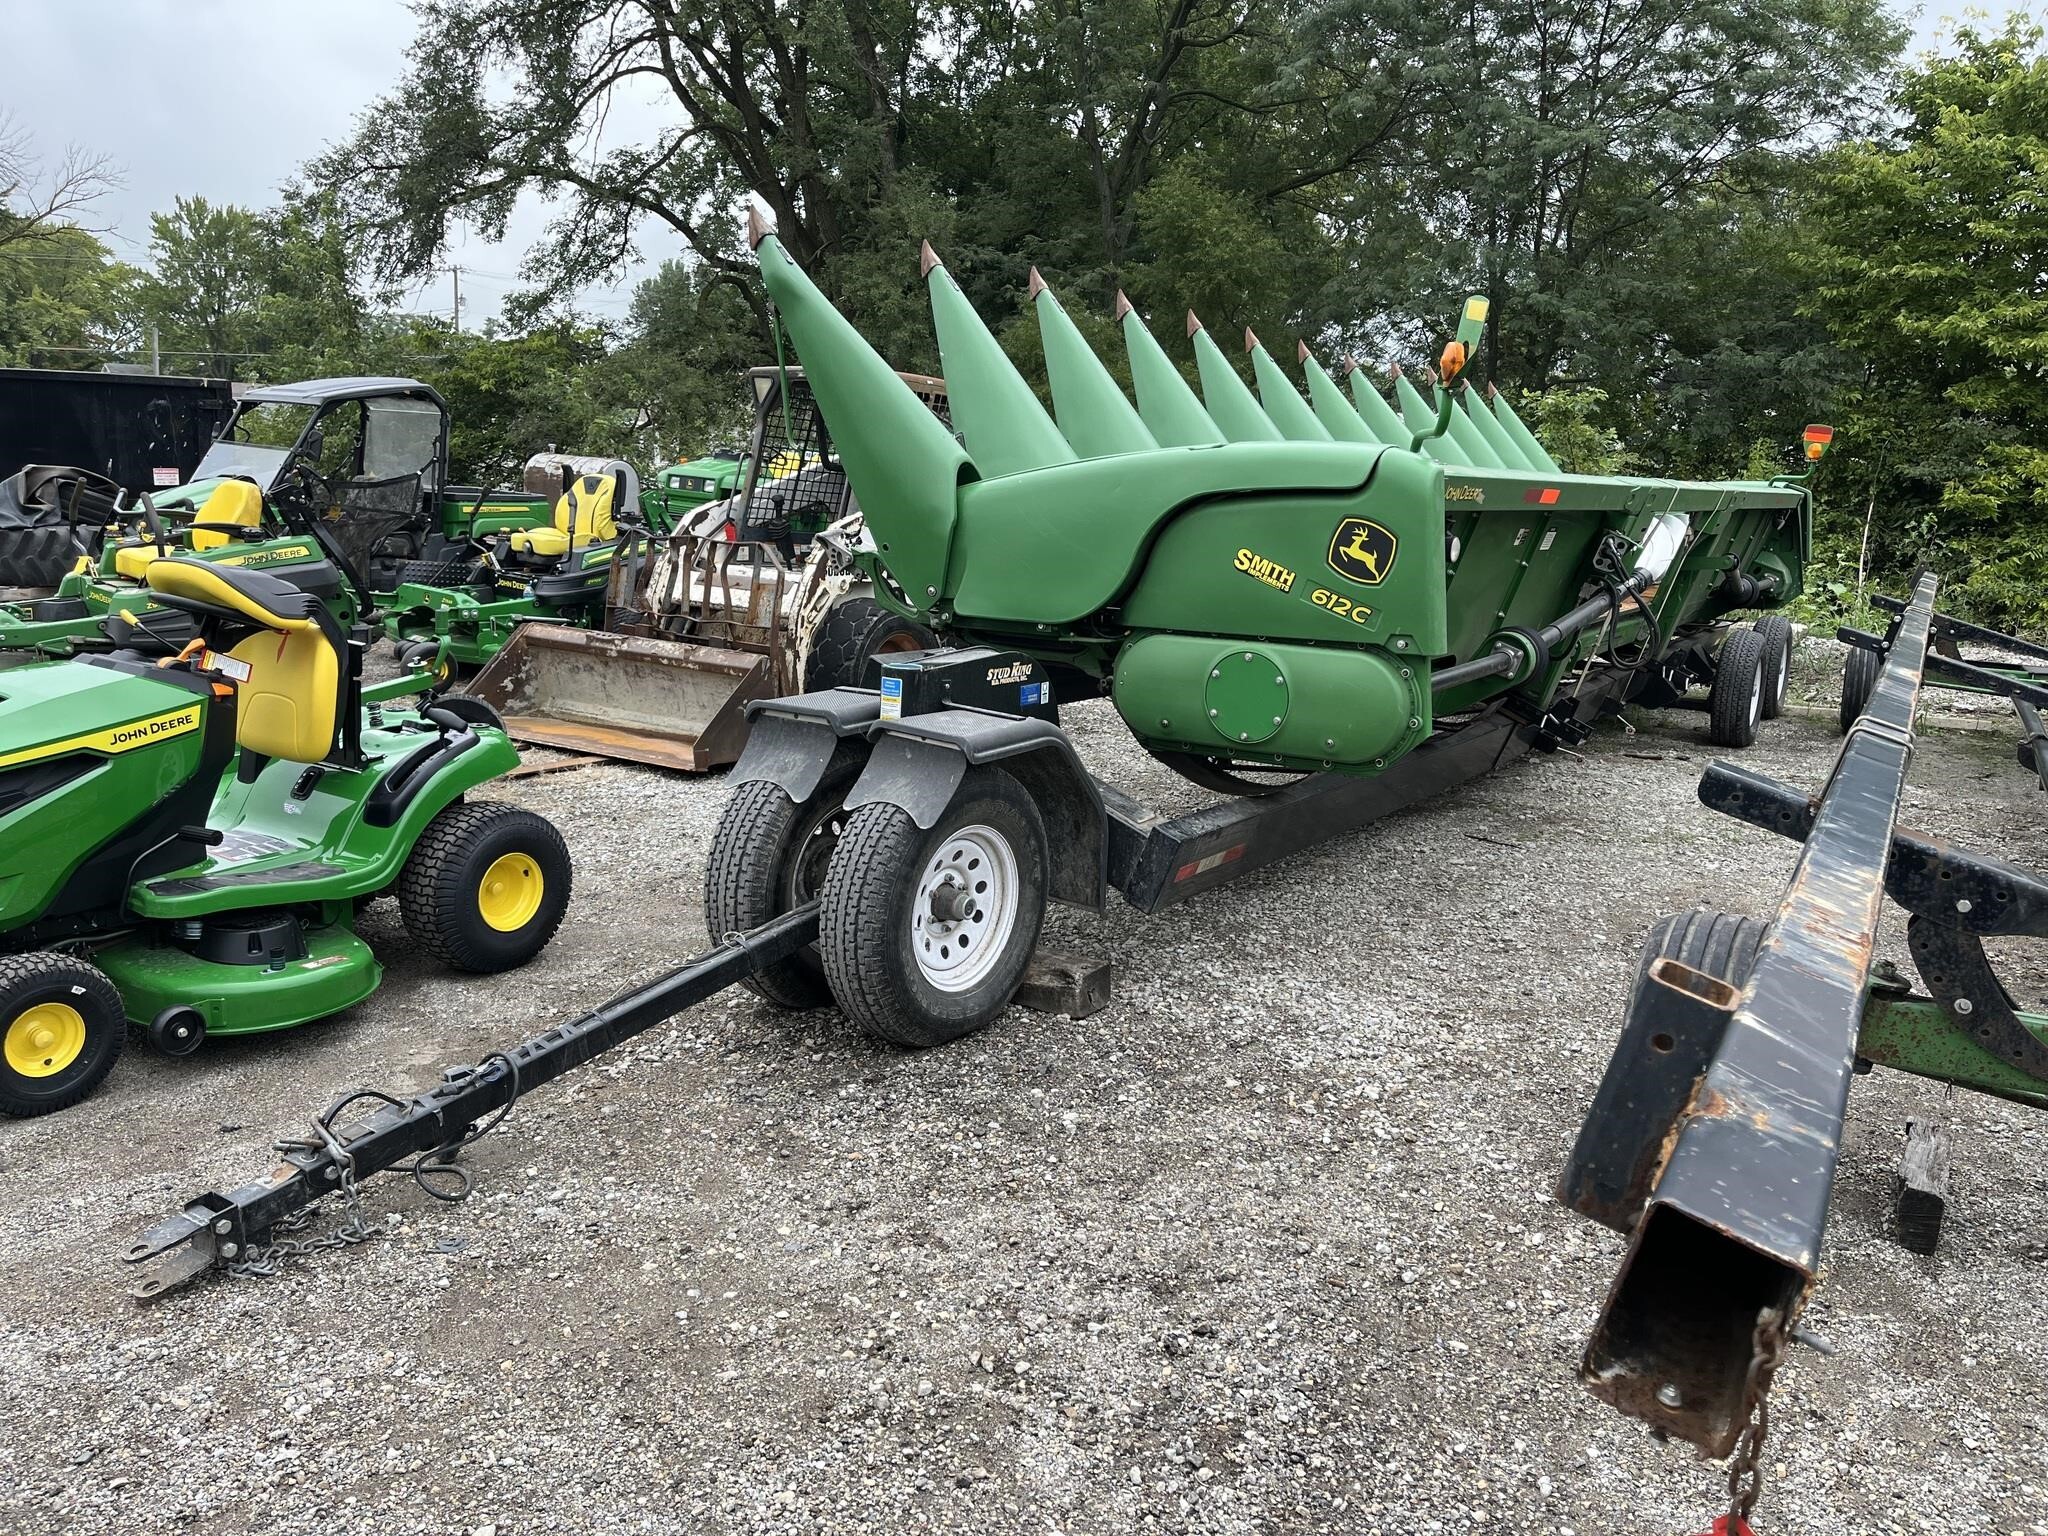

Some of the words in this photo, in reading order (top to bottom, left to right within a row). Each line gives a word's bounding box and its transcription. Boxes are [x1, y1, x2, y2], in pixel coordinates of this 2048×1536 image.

[241, 553, 269, 565] JOHN
[269, 549, 302, 560] DEERE
[1233, 548, 1296, 586] SMITH
[498, 578, 512, 588] JOHN
[512, 580, 527, 590] DEER
[1247, 567, 1290, 592] IMPLEMENTS
[1311, 588, 1372, 624] 612C
[986, 667, 1010, 680] STUD
[1010, 664, 1032, 677] KING
[110, 727, 148, 746] JOHN
[149, 714, 193, 735] DEERE
